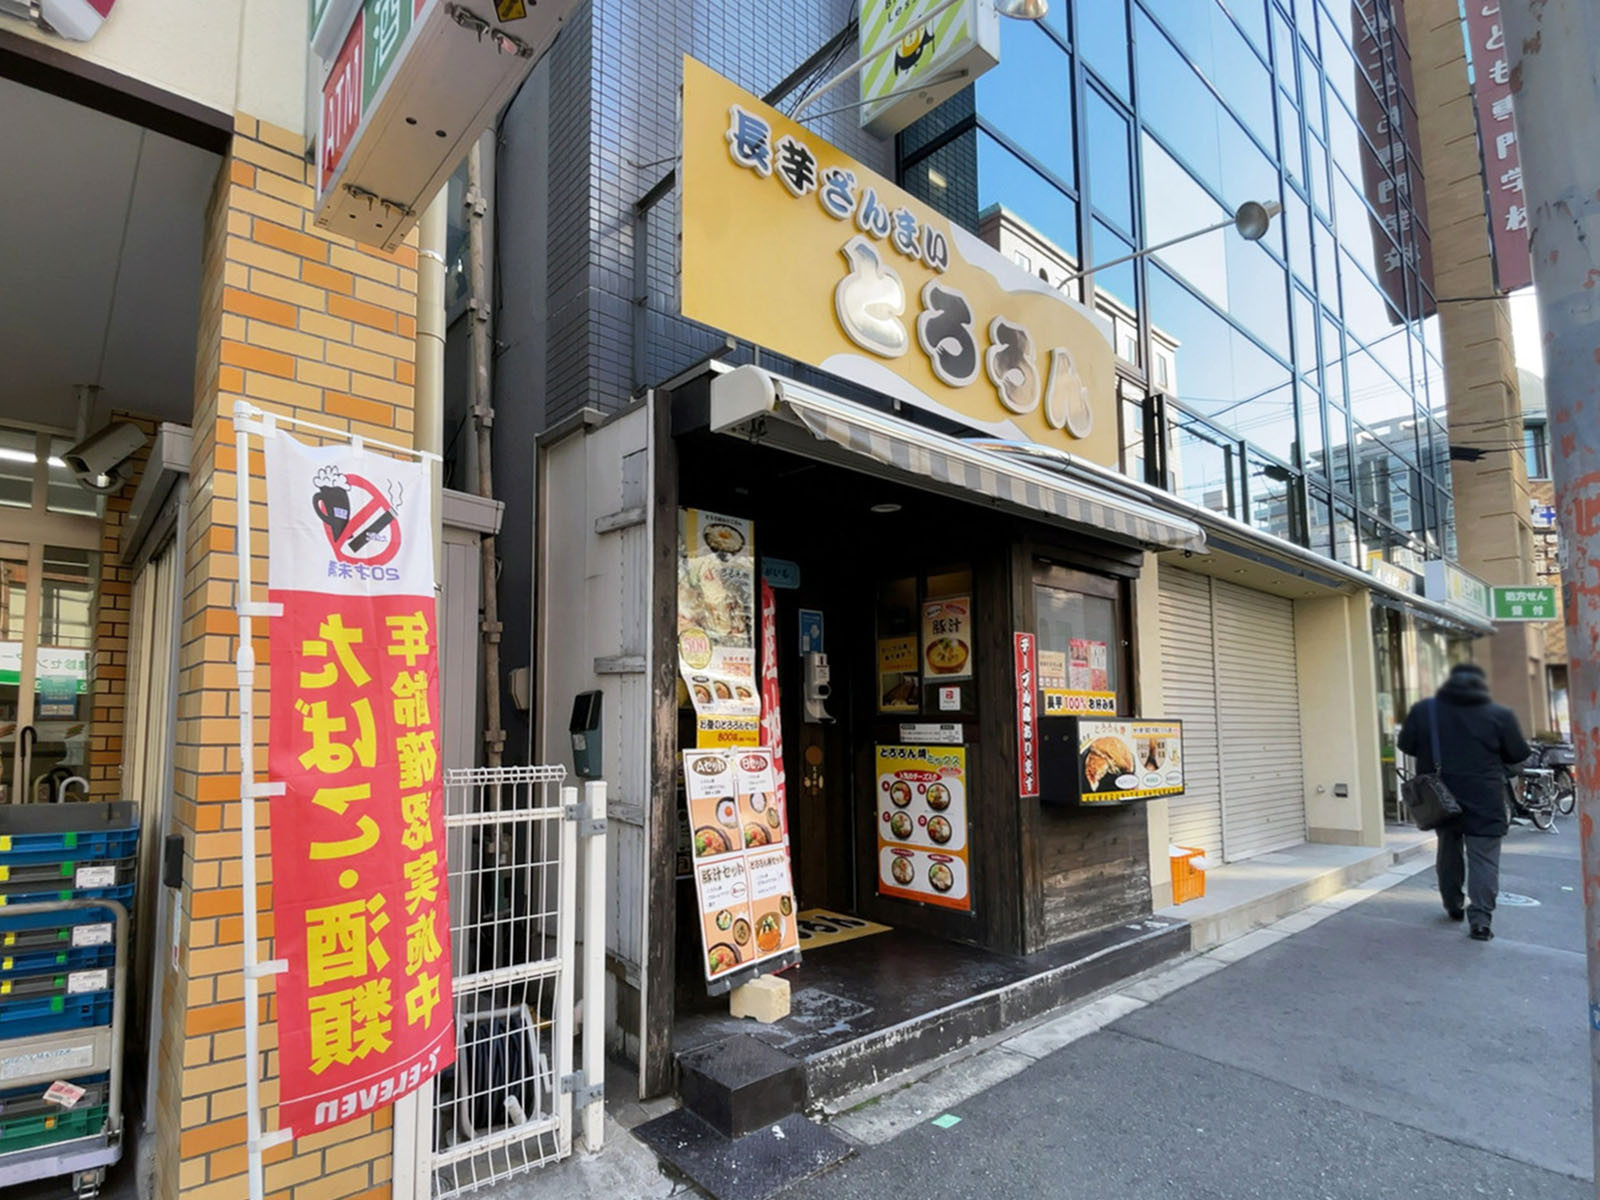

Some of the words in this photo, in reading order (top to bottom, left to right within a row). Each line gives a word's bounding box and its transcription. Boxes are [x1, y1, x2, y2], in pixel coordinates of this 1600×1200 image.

[324, 45, 361, 170] ATM
[726, 104, 949, 274] 長芋ざんまい
[835, 235, 1092, 440] とろろん
[1505, 591, 1547, 601] 処方せん
